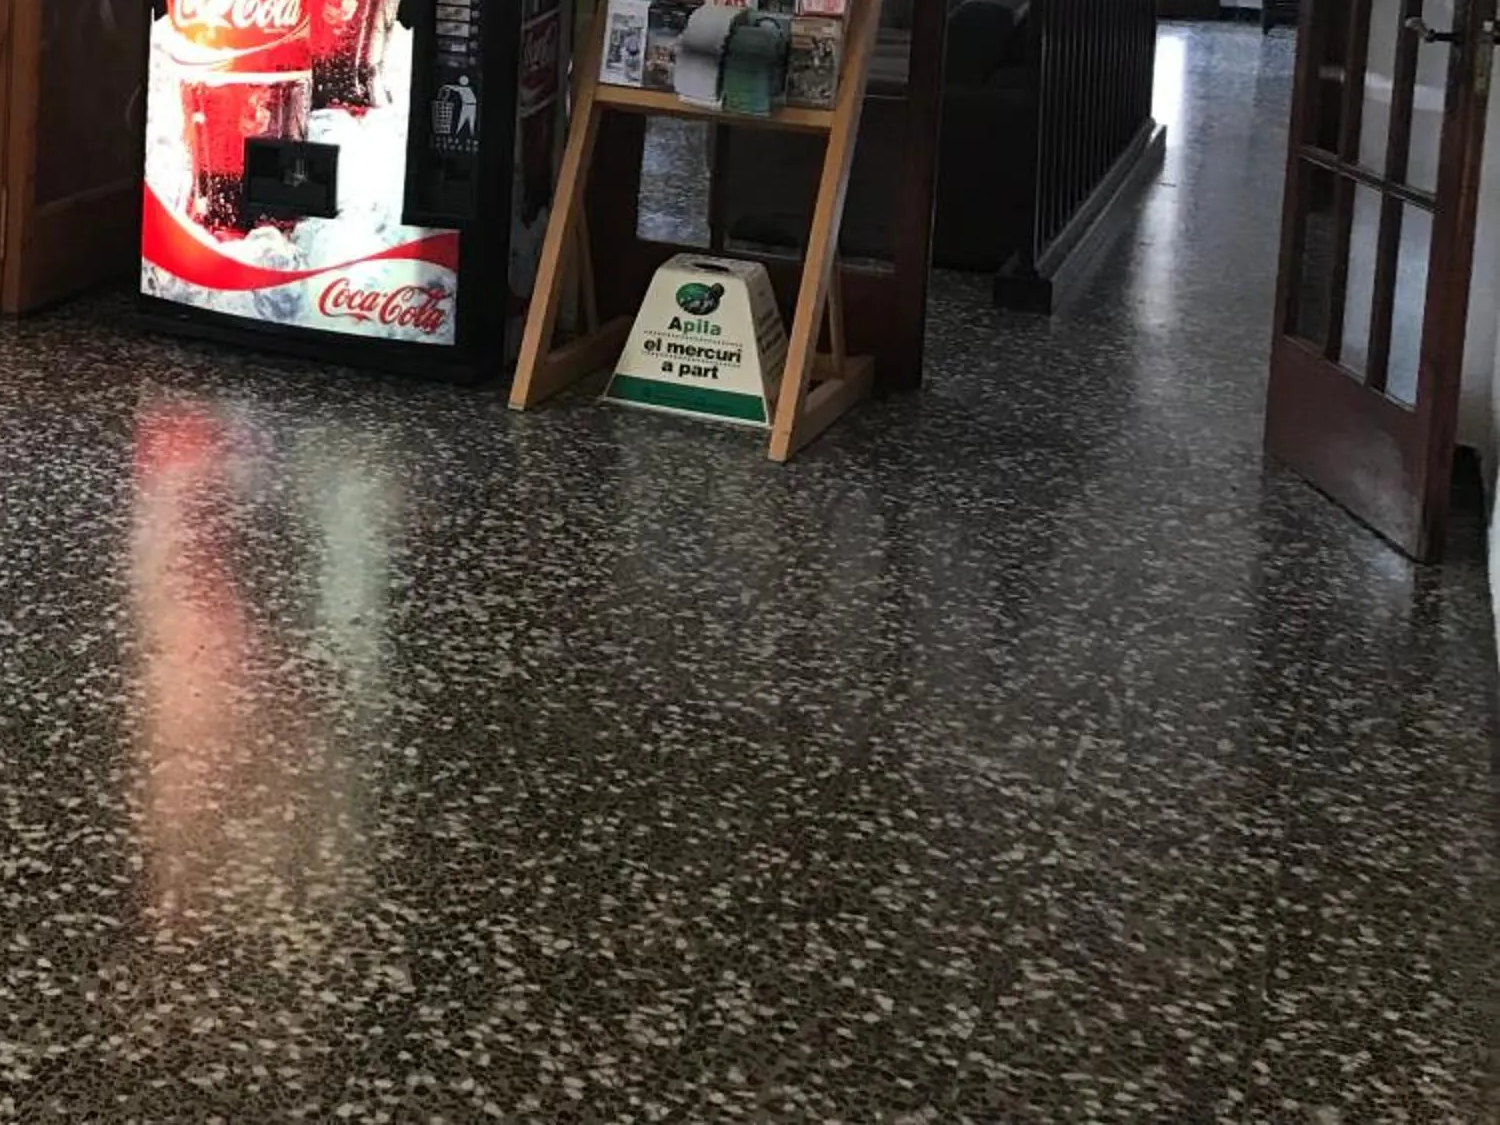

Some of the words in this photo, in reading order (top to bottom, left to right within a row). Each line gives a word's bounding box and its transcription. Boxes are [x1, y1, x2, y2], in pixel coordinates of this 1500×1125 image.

[318, 277, 452, 334] Coca-Cola
[668, 316, 722, 336] Apila
[643, 338, 662, 352] el
[667, 341, 742, 363] mercuri
[661, 360, 673, 373] a
[678, 363, 719, 380] part
